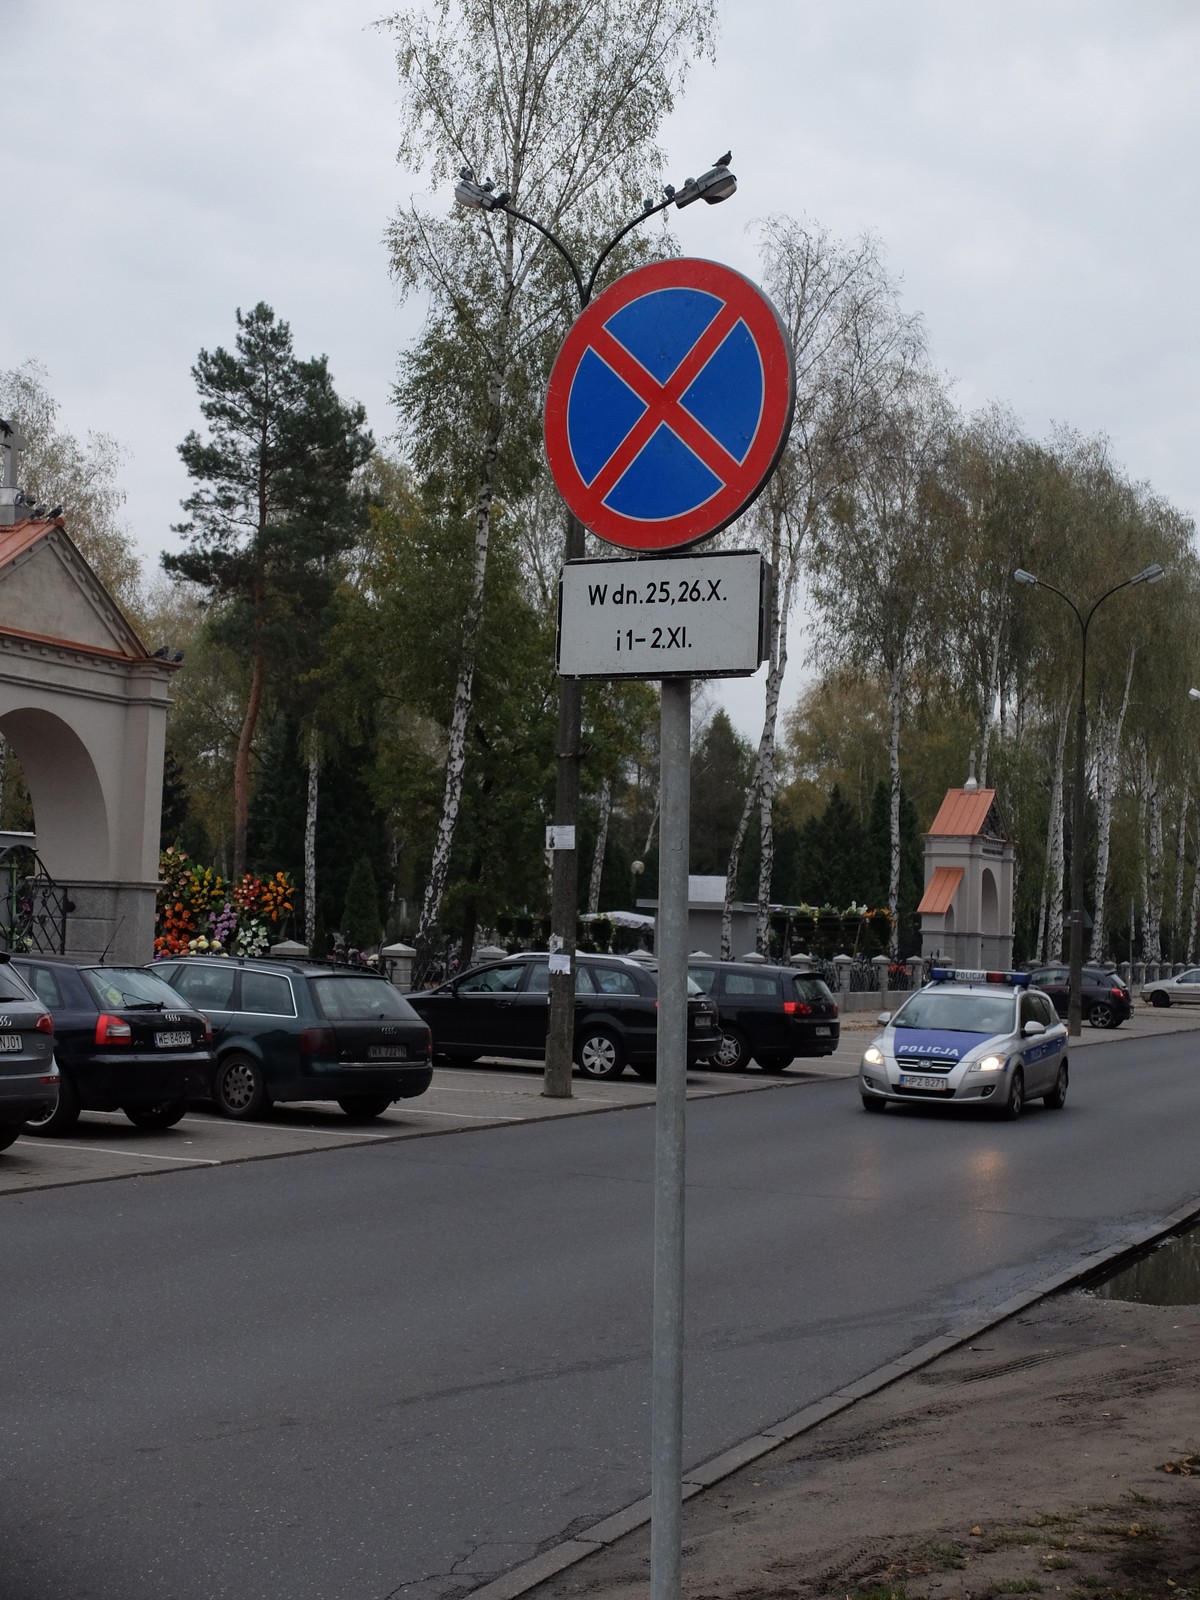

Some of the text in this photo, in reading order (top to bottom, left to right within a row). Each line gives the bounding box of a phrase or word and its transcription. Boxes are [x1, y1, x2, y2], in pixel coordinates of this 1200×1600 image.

[956, 971, 985, 981] POLICJA
[157, 1031, 191, 1045] WE 8489P
[898, 1045, 960, 1057] POLICJA
[905, 1076, 923, 1087] HPZ
